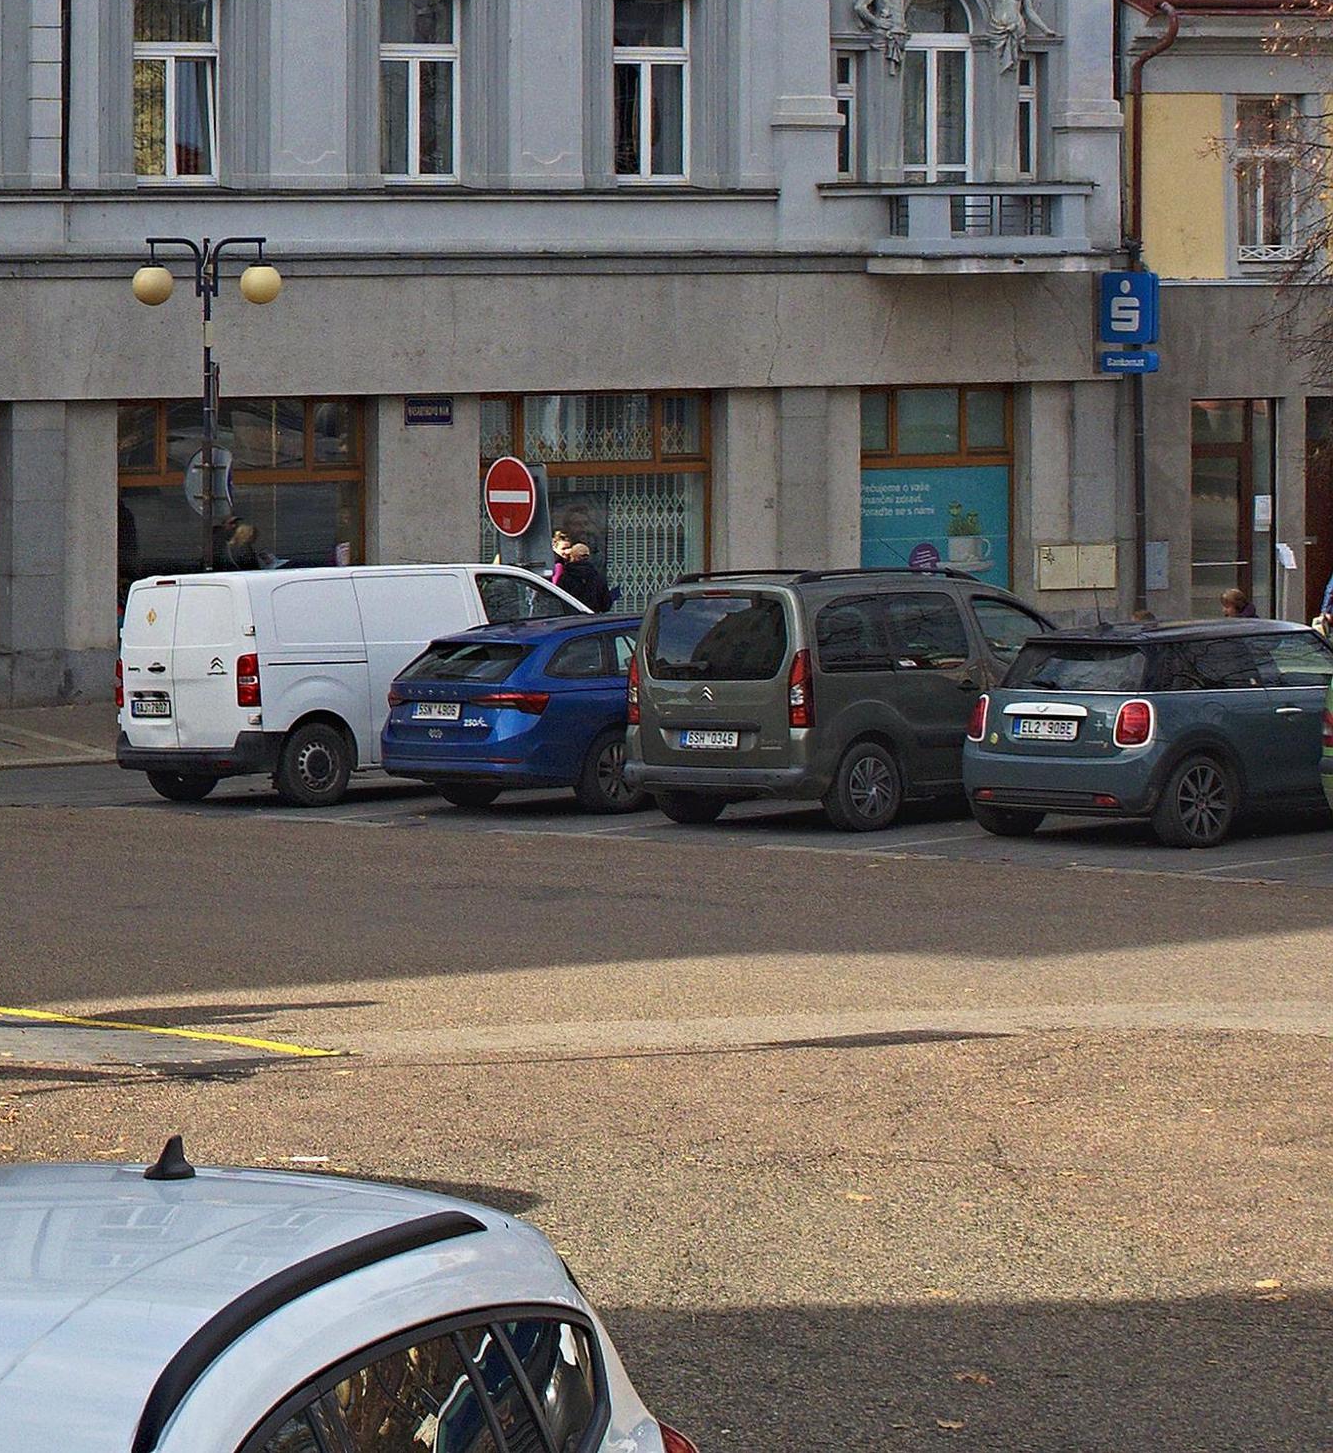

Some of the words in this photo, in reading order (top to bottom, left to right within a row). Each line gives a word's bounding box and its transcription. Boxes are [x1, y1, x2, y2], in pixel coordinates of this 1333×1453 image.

[1021, 720, 1041, 734] EL2
[687, 731, 705, 744] 6SH
[710, 732, 734, 745] 0346
